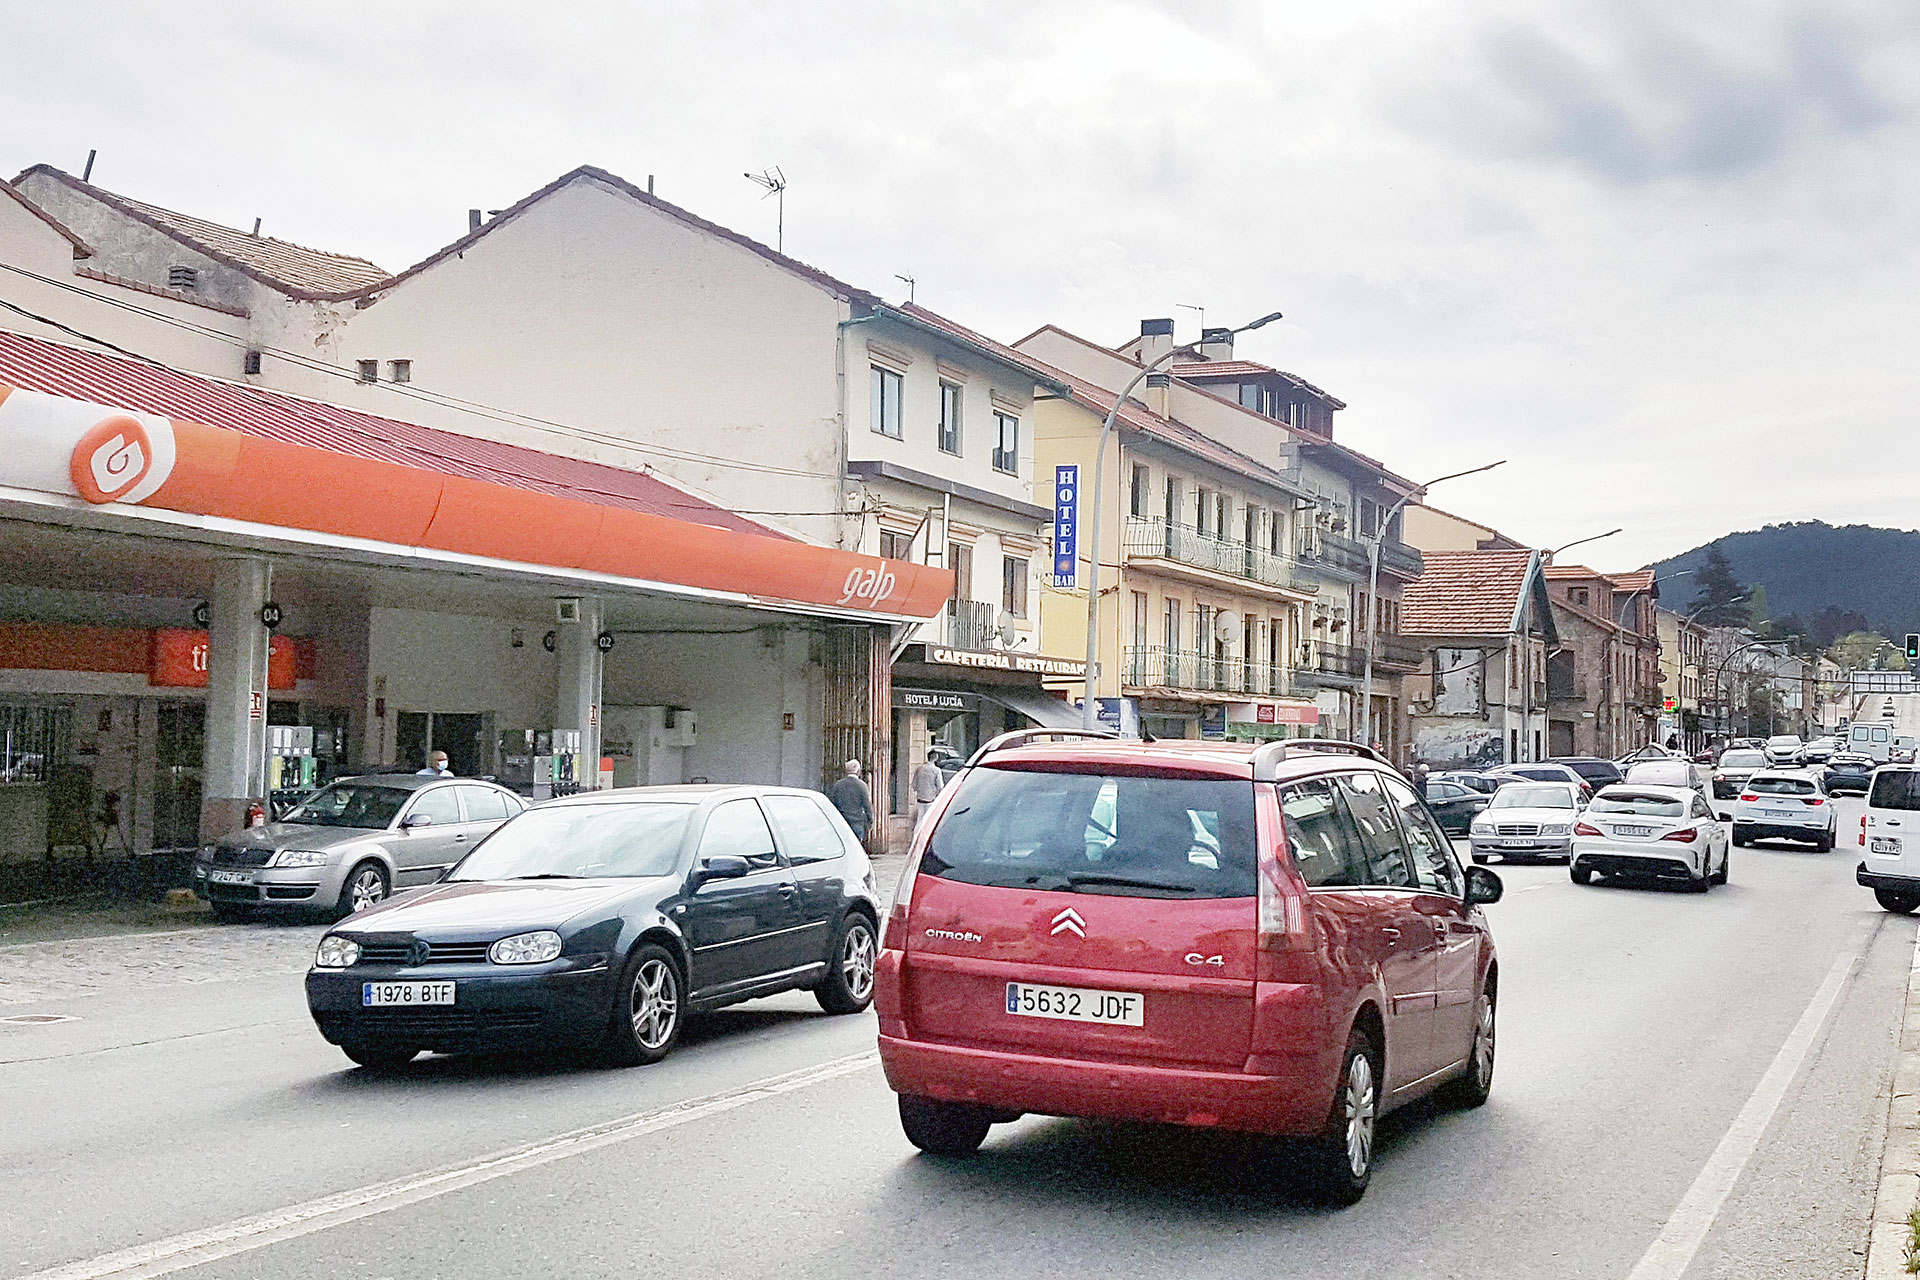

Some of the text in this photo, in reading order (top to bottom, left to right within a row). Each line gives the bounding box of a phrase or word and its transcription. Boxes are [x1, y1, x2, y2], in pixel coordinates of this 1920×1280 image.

[1059, 470, 1075, 555] HOTEL
[836, 560, 896, 608] galp
[1054, 574, 1075, 587] BAR
[263, 608, 279, 622] 04
[599, 637, 612, 648] 02
[933, 649, 1010, 669] CAFETERÍA
[905, 694, 932, 705] HOTEL
[925, 928, 983, 943] CITROËN
[1184, 952, 1225, 968] C4
[375, 985, 452, 1002] 1978 BTF
[1023, 988, 1137, 1020] 5632 JDF
